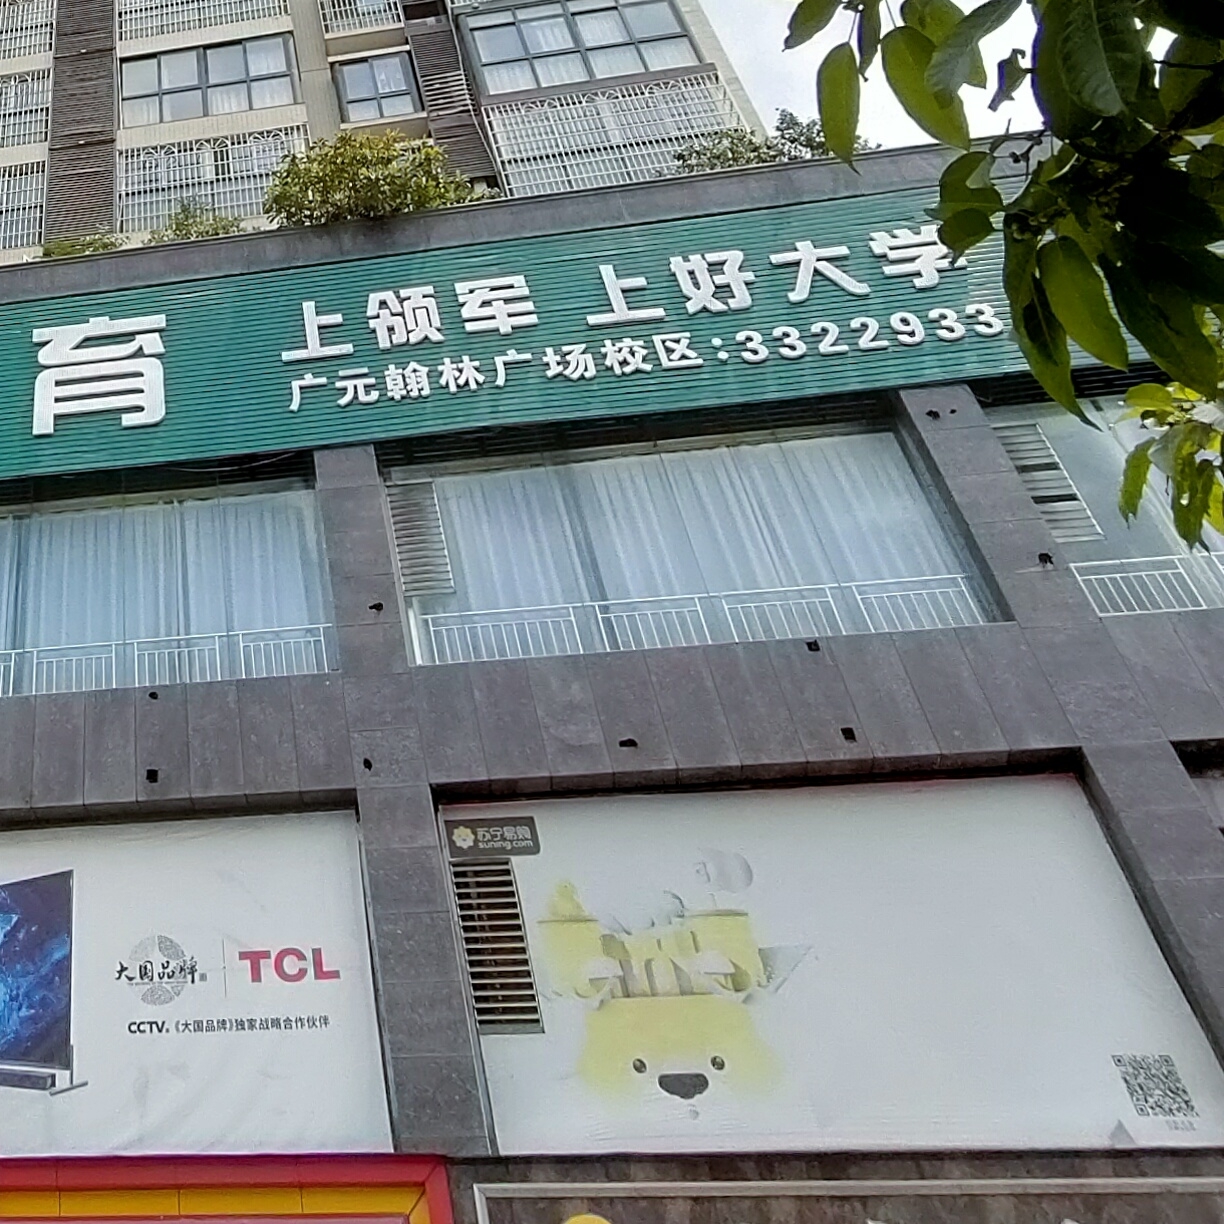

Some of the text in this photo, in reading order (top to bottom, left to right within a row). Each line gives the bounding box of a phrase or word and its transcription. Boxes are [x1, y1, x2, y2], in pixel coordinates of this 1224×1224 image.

[281, 224, 969, 363] 上领军 上好大学
[288, 303, 1004, 413] 广元翰林广场校区:3322933
[115, 956, 199, 985] 大国品牌
[238, 947, 341, 983] TCL
[173, 1015, 331, 1034] 《大国品牌》独家战略合作伙伴
